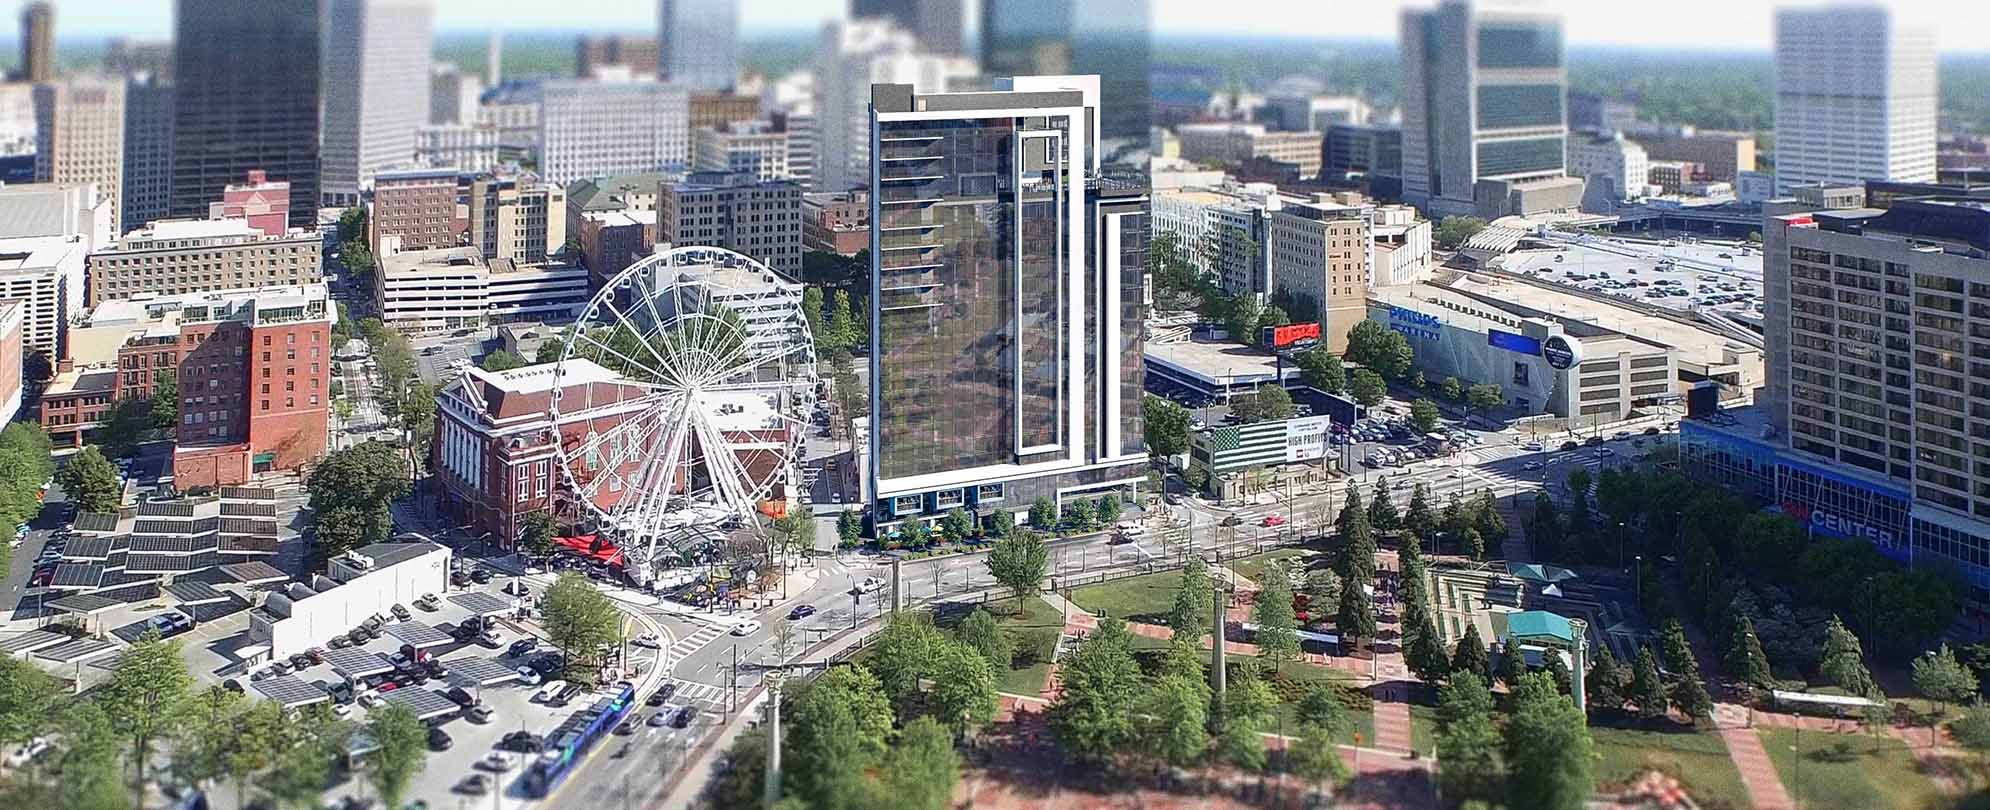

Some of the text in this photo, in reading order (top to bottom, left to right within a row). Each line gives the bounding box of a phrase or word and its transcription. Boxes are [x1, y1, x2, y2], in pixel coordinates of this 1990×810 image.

[1390, 305, 1440, 328] PHILIPS
[1303, 432, 1328, 445] PROFITS
[1811, 510, 1893, 549] CENTER
